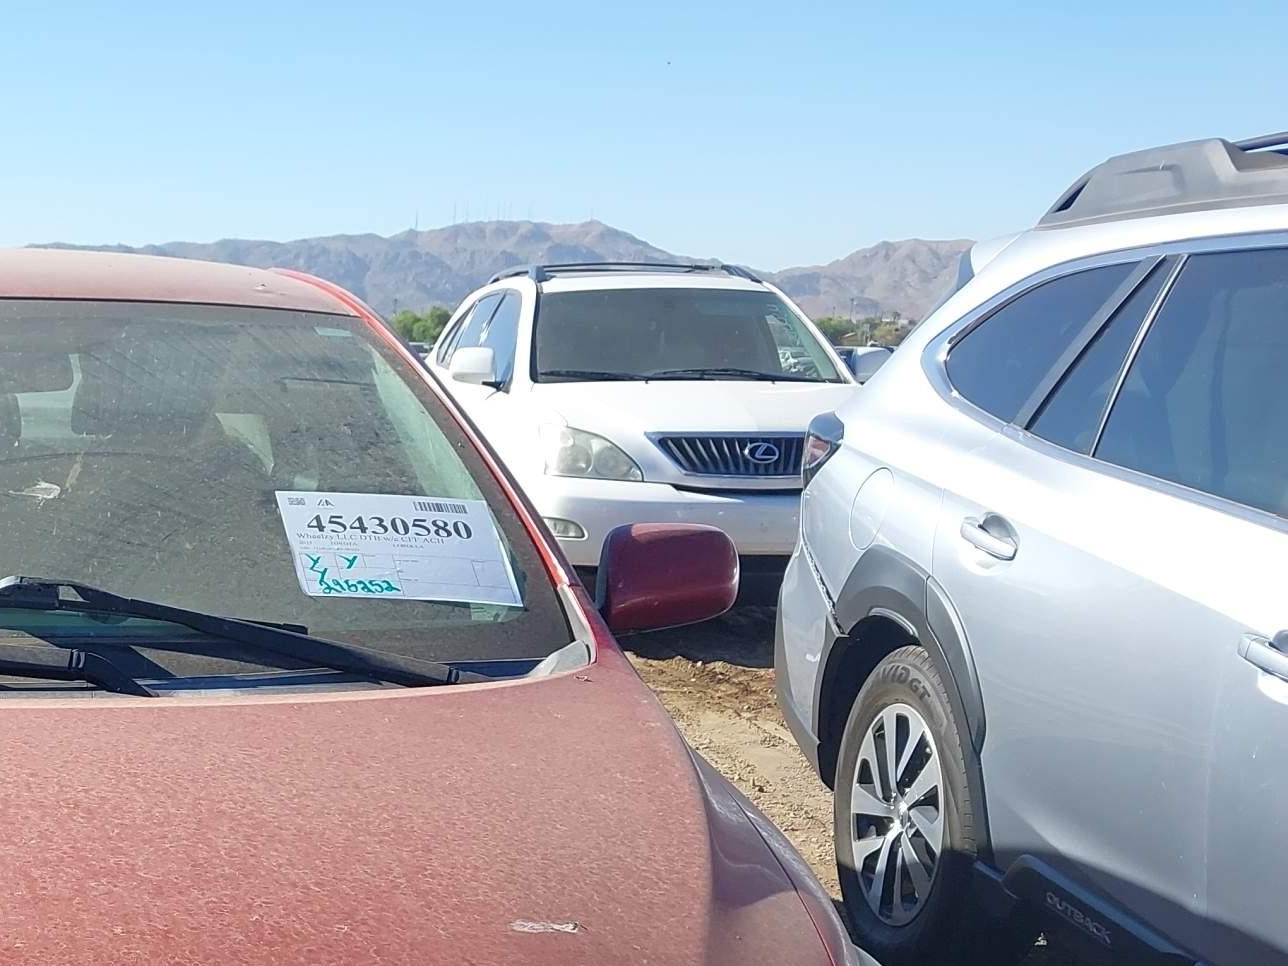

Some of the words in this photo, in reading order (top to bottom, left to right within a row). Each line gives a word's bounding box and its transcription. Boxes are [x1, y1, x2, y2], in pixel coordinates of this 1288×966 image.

[306, 513, 473, 540] 45430580
[910, 678, 931, 701] GT
[1045, 891, 1112, 944] OUTBACK
